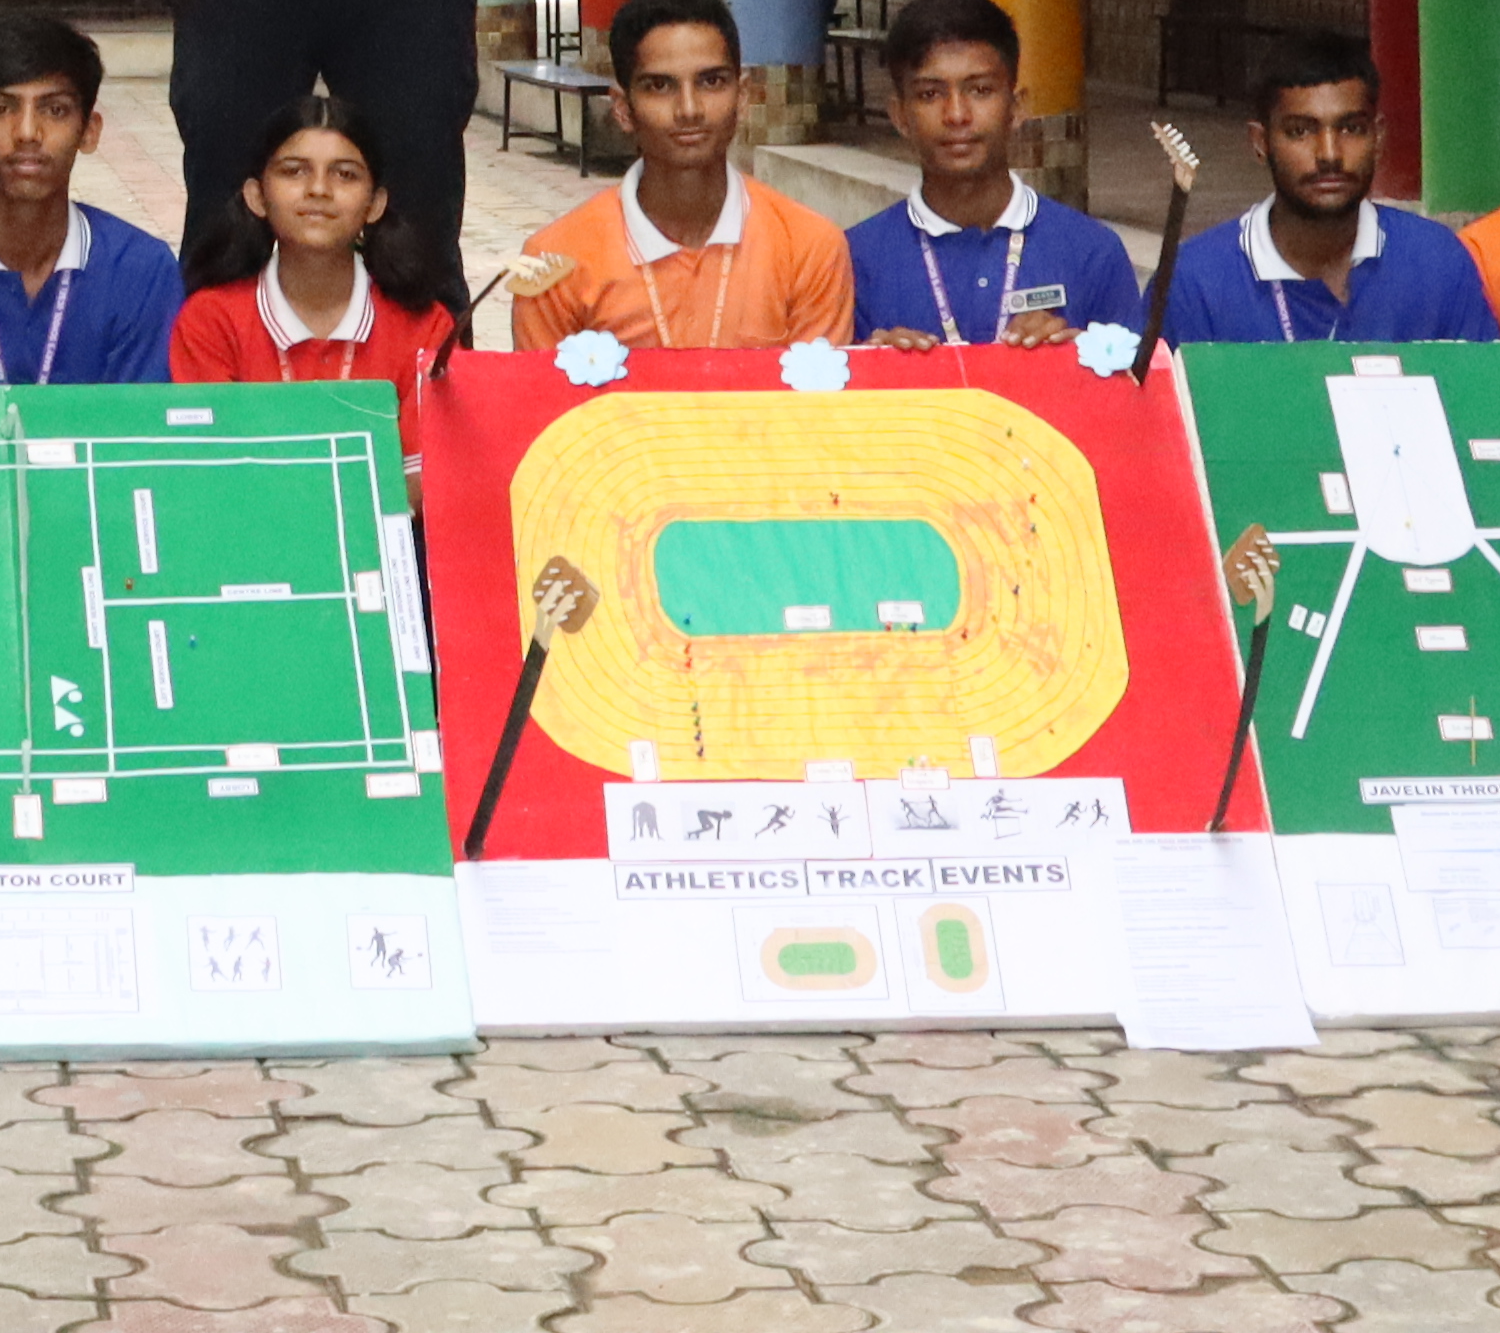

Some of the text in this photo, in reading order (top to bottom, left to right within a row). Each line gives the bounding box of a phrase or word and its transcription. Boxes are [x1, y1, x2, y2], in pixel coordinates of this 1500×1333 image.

[1369, 784, 1444, 797] JAVELIN
[49, 872, 127, 887] COURT
[625, 864, 1066, 891] ATHLETICS TRACK EVENTS
